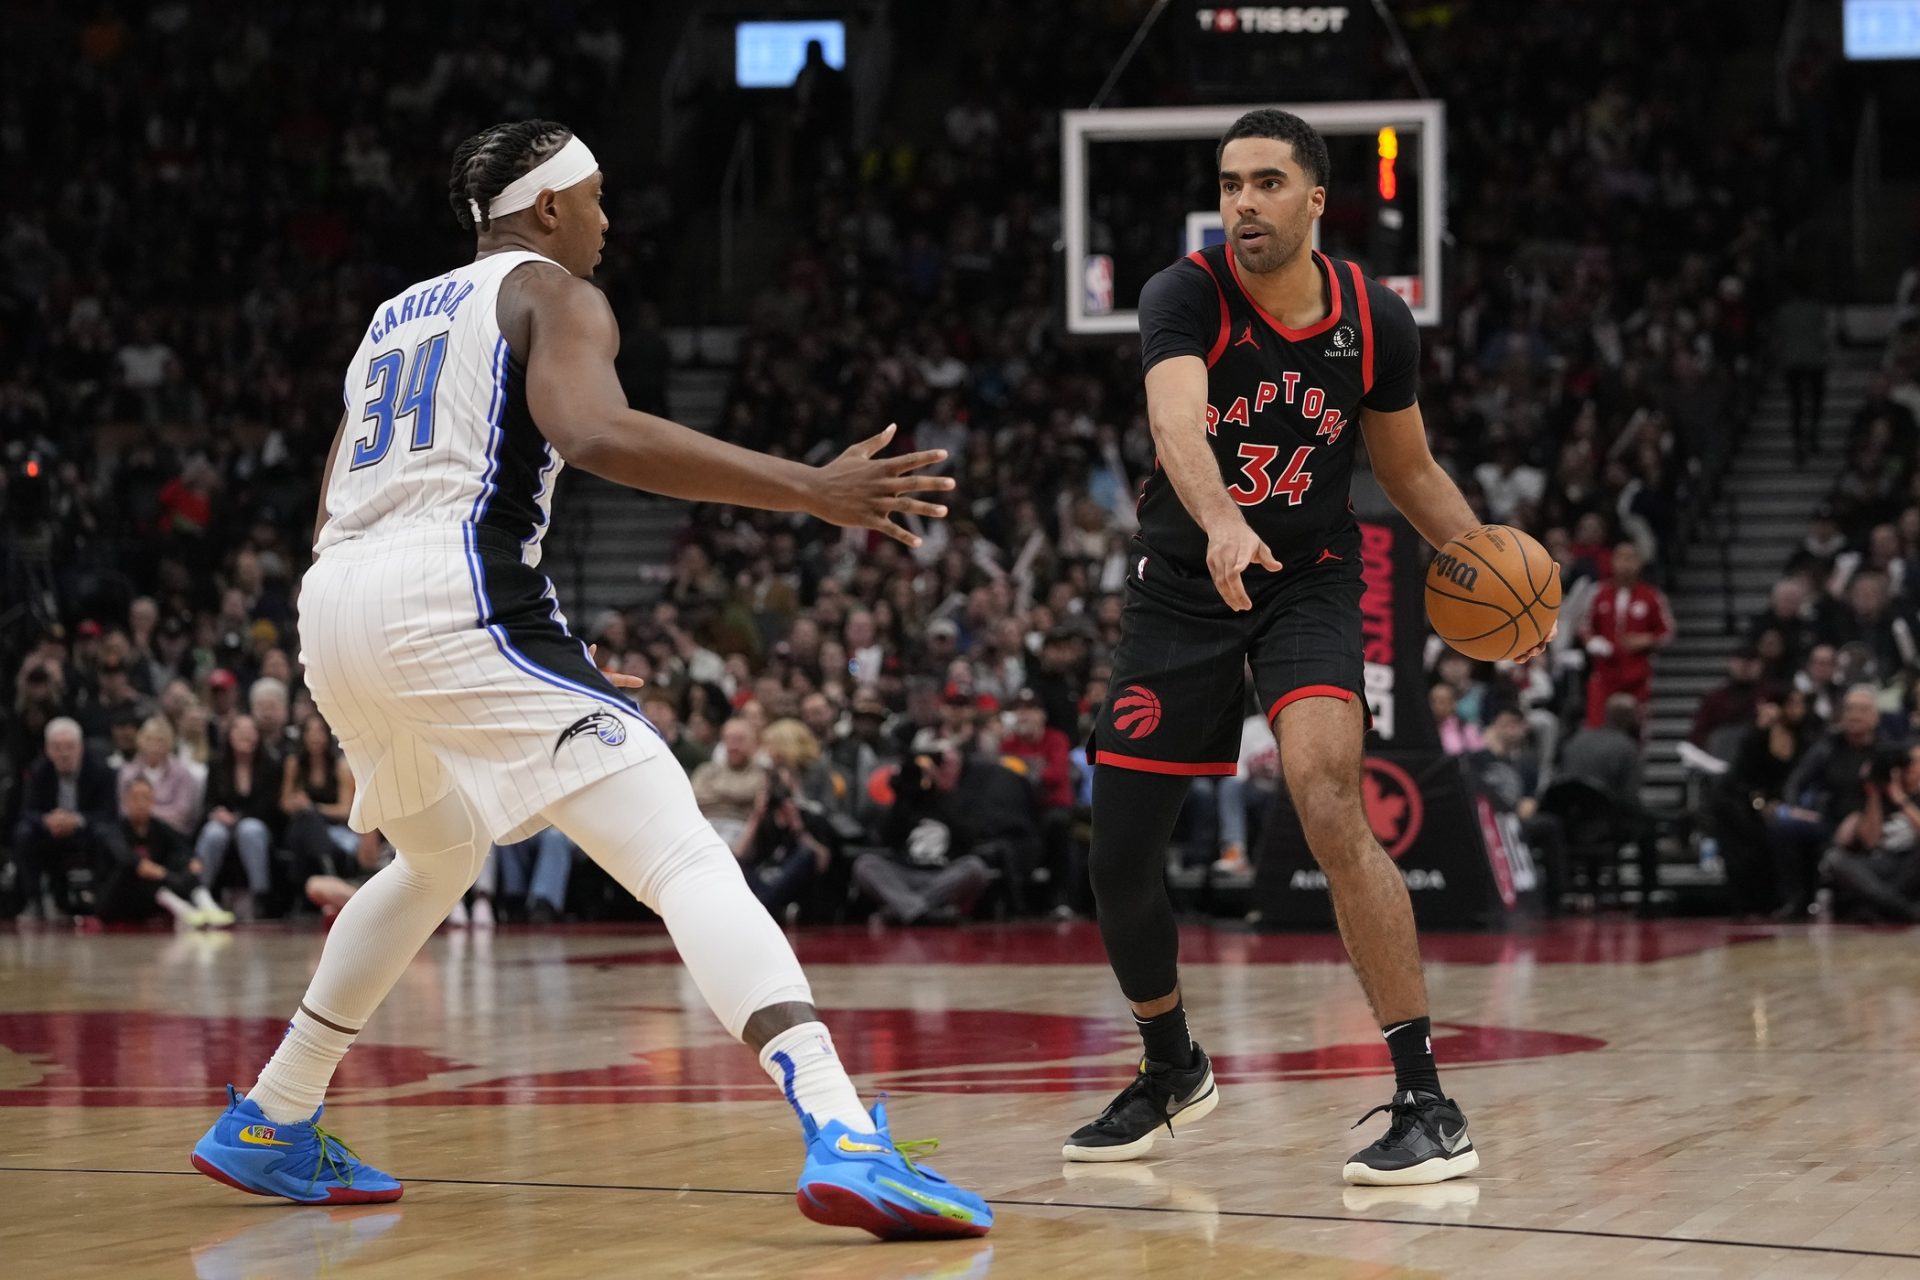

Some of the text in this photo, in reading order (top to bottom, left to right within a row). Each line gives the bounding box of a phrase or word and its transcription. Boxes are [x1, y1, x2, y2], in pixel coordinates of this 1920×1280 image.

[371, 281, 457, 344] CARTER
[1323, 348, 1359, 357] Sun Life
[350, 331, 449, 472] 34
[1206, 372, 1348, 445] RAPTORS
[1226, 442, 1316, 506] 34
